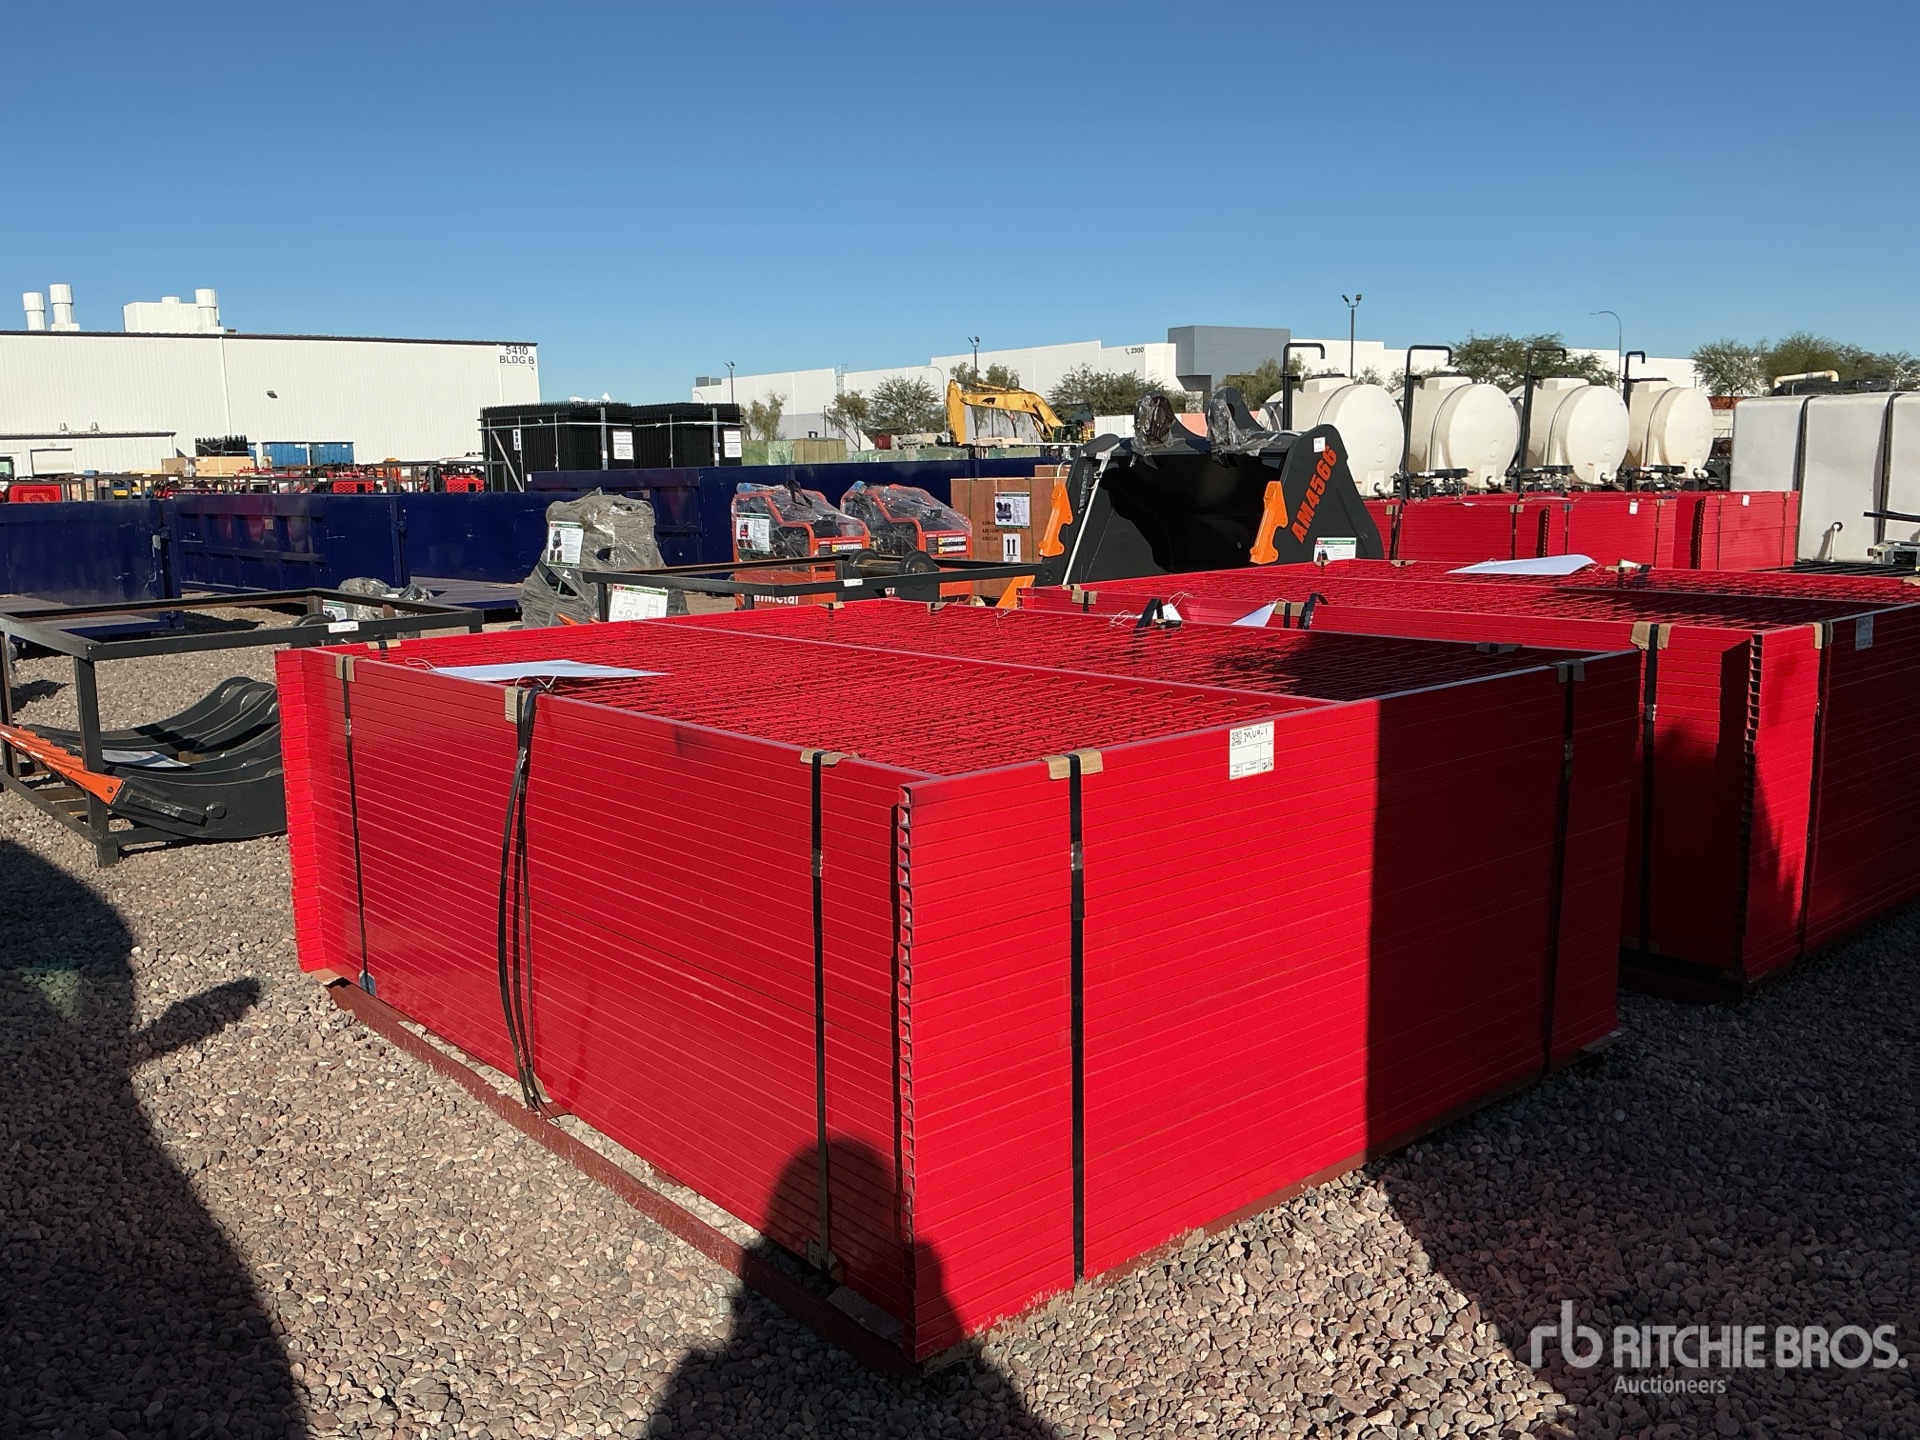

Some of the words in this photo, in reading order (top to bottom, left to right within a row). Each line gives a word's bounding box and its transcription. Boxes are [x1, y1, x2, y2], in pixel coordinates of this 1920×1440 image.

[505, 345, 528, 355] 5410
[500, 355, 526, 364] BLDG
[528, 356, 534, 364] B
[1291, 445, 1337, 544] AM4566
